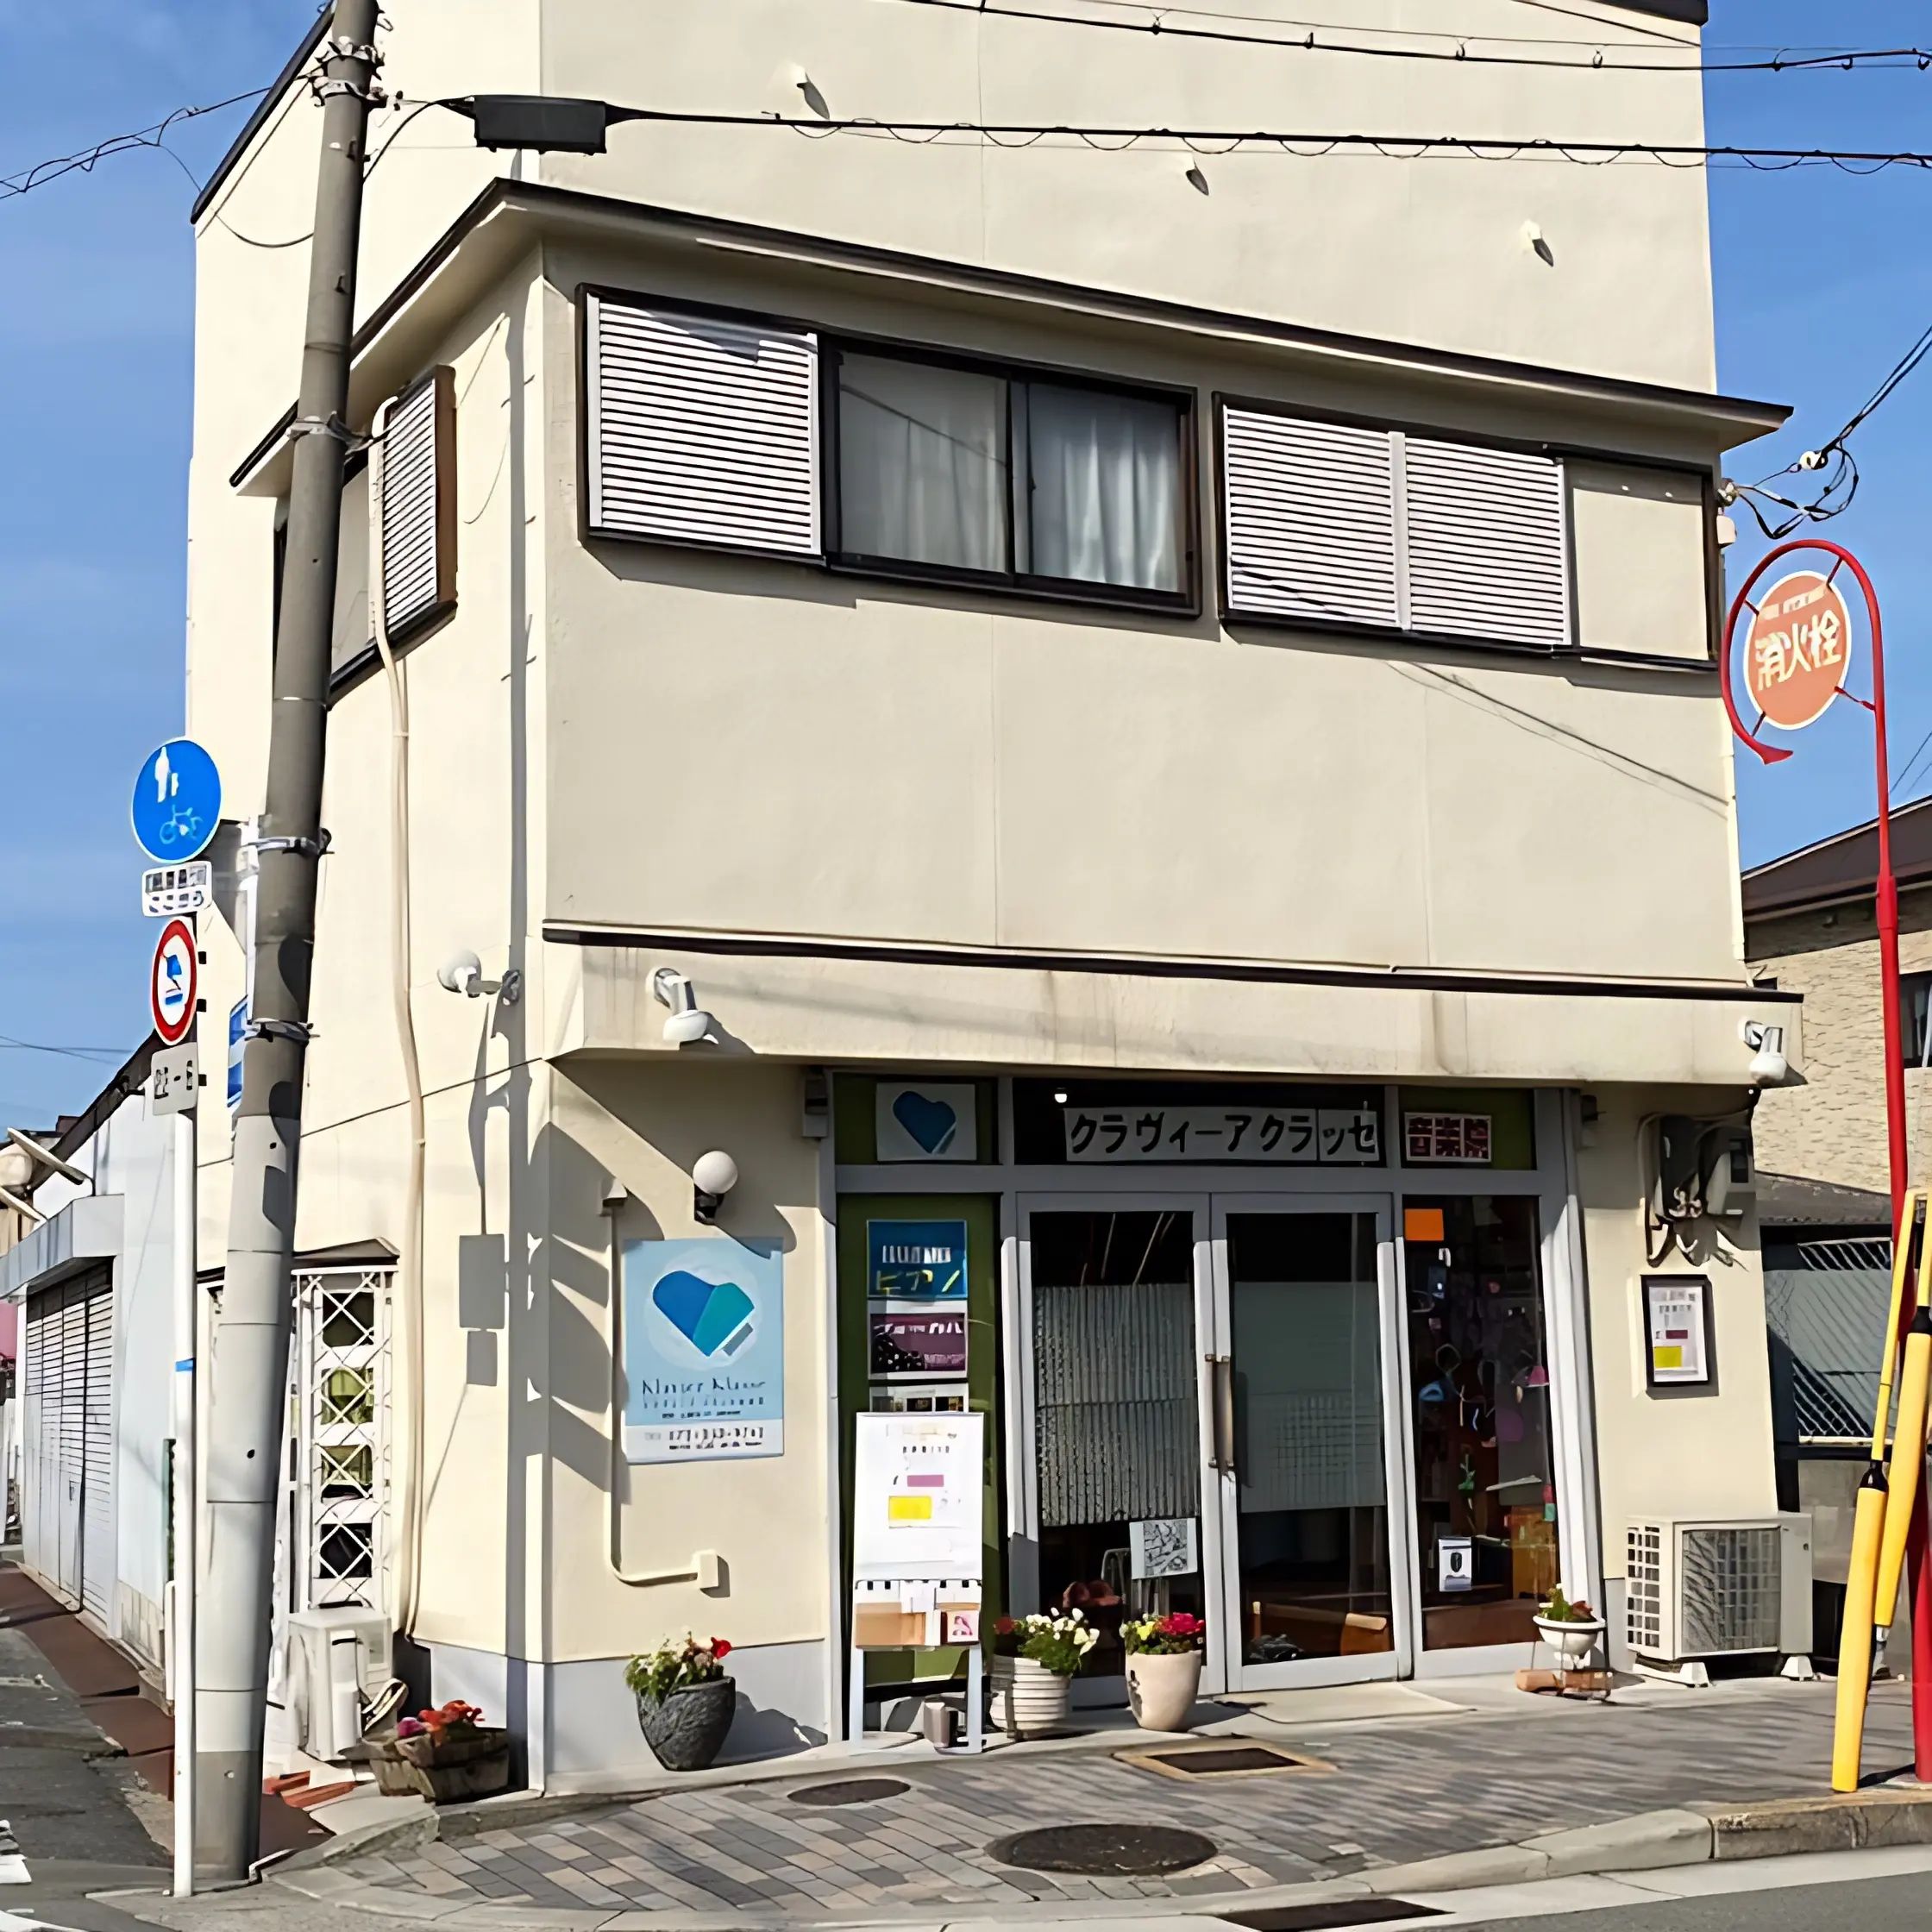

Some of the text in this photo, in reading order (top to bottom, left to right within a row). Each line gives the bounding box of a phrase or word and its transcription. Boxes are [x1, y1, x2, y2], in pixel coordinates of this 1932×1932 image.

[1754, 609, 1842, 692] 消火栓
[1070, 1111, 1376, 1155] クラヴィーアクラッセ
